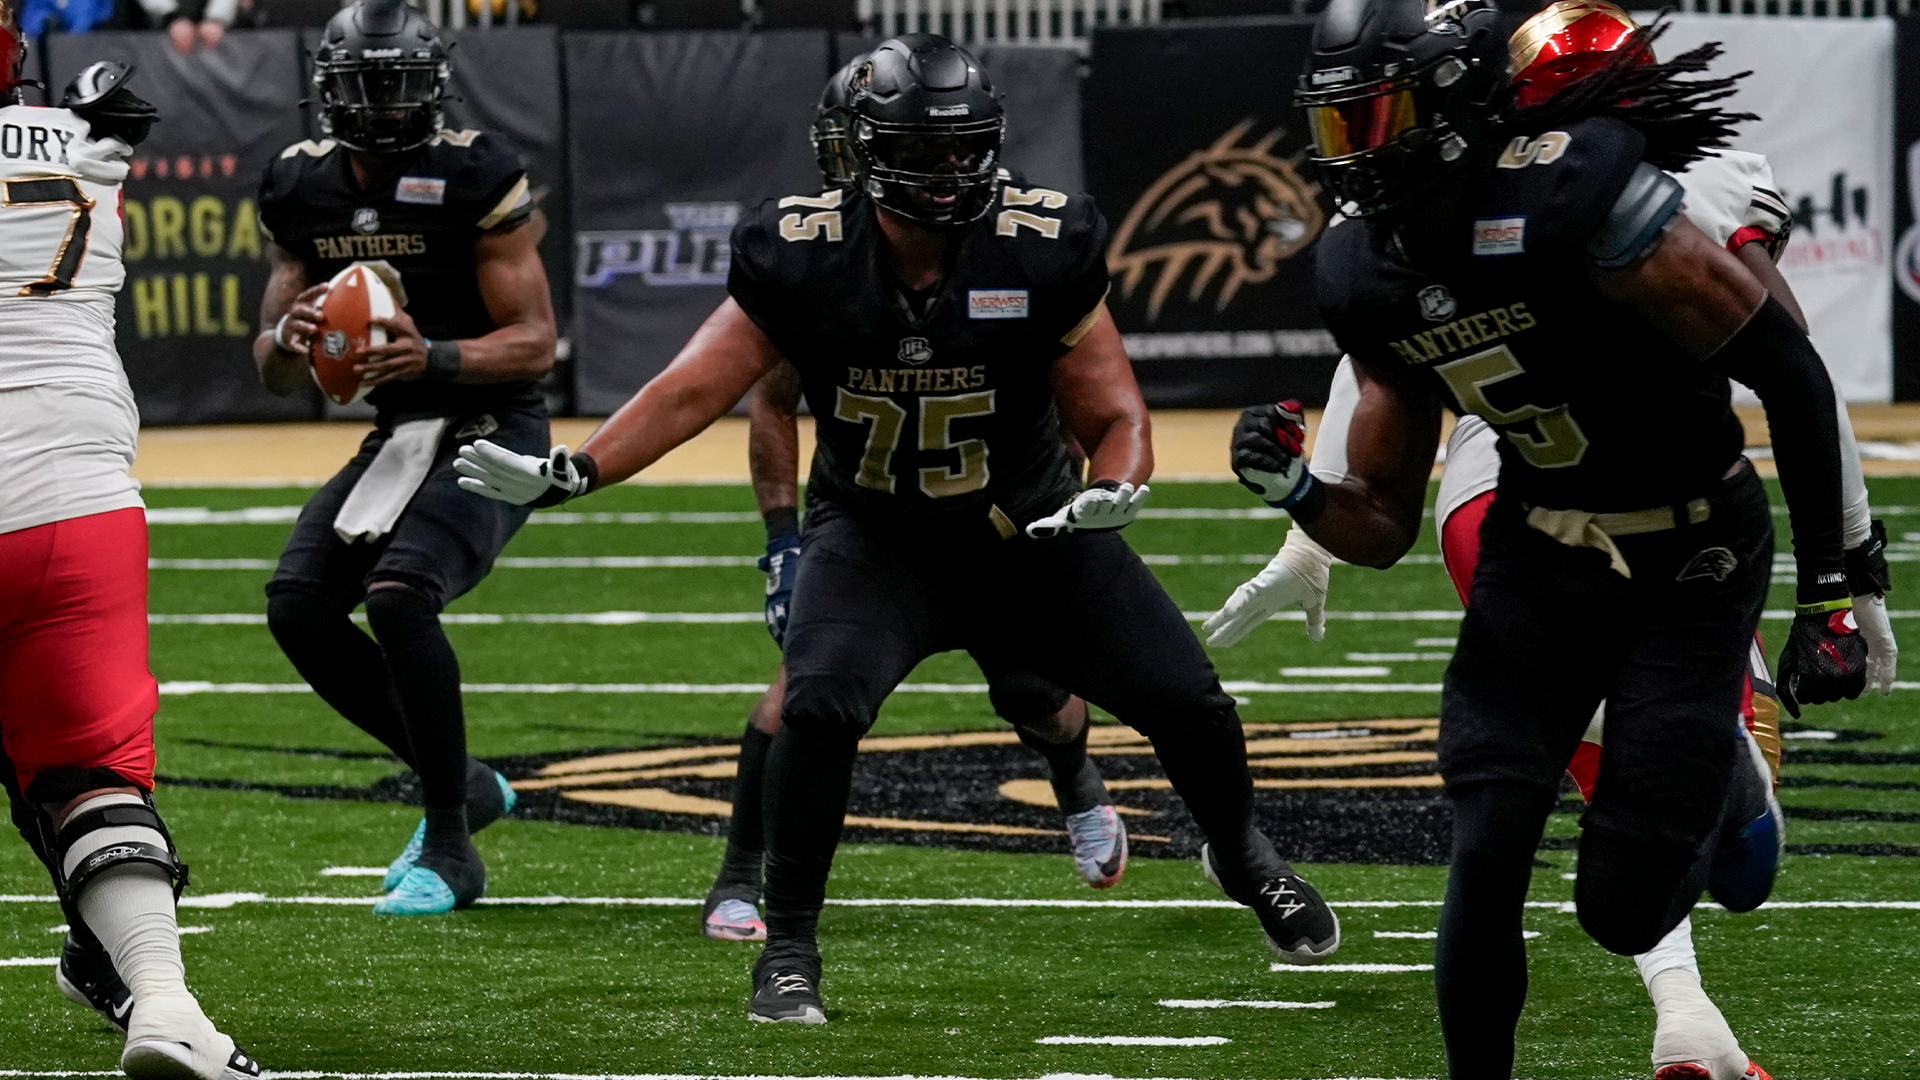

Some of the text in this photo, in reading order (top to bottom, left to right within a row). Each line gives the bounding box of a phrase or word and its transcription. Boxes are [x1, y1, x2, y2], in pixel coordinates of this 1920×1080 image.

[2, 123, 75, 166] ORY
[1497, 131, 1572, 169] 5
[2, 175, 96, 296] 7
[778, 188, 843, 242] 75
[996, 186, 1068, 239] 75
[313, 233, 426, 259] PANTHERS
[132, 273, 249, 338] HILL
[847, 365, 986, 392] PANTHERS
[1433, 343, 1590, 468] 5
[834, 386, 996, 499] 75
[90, 846, 140, 866] DONJOY
